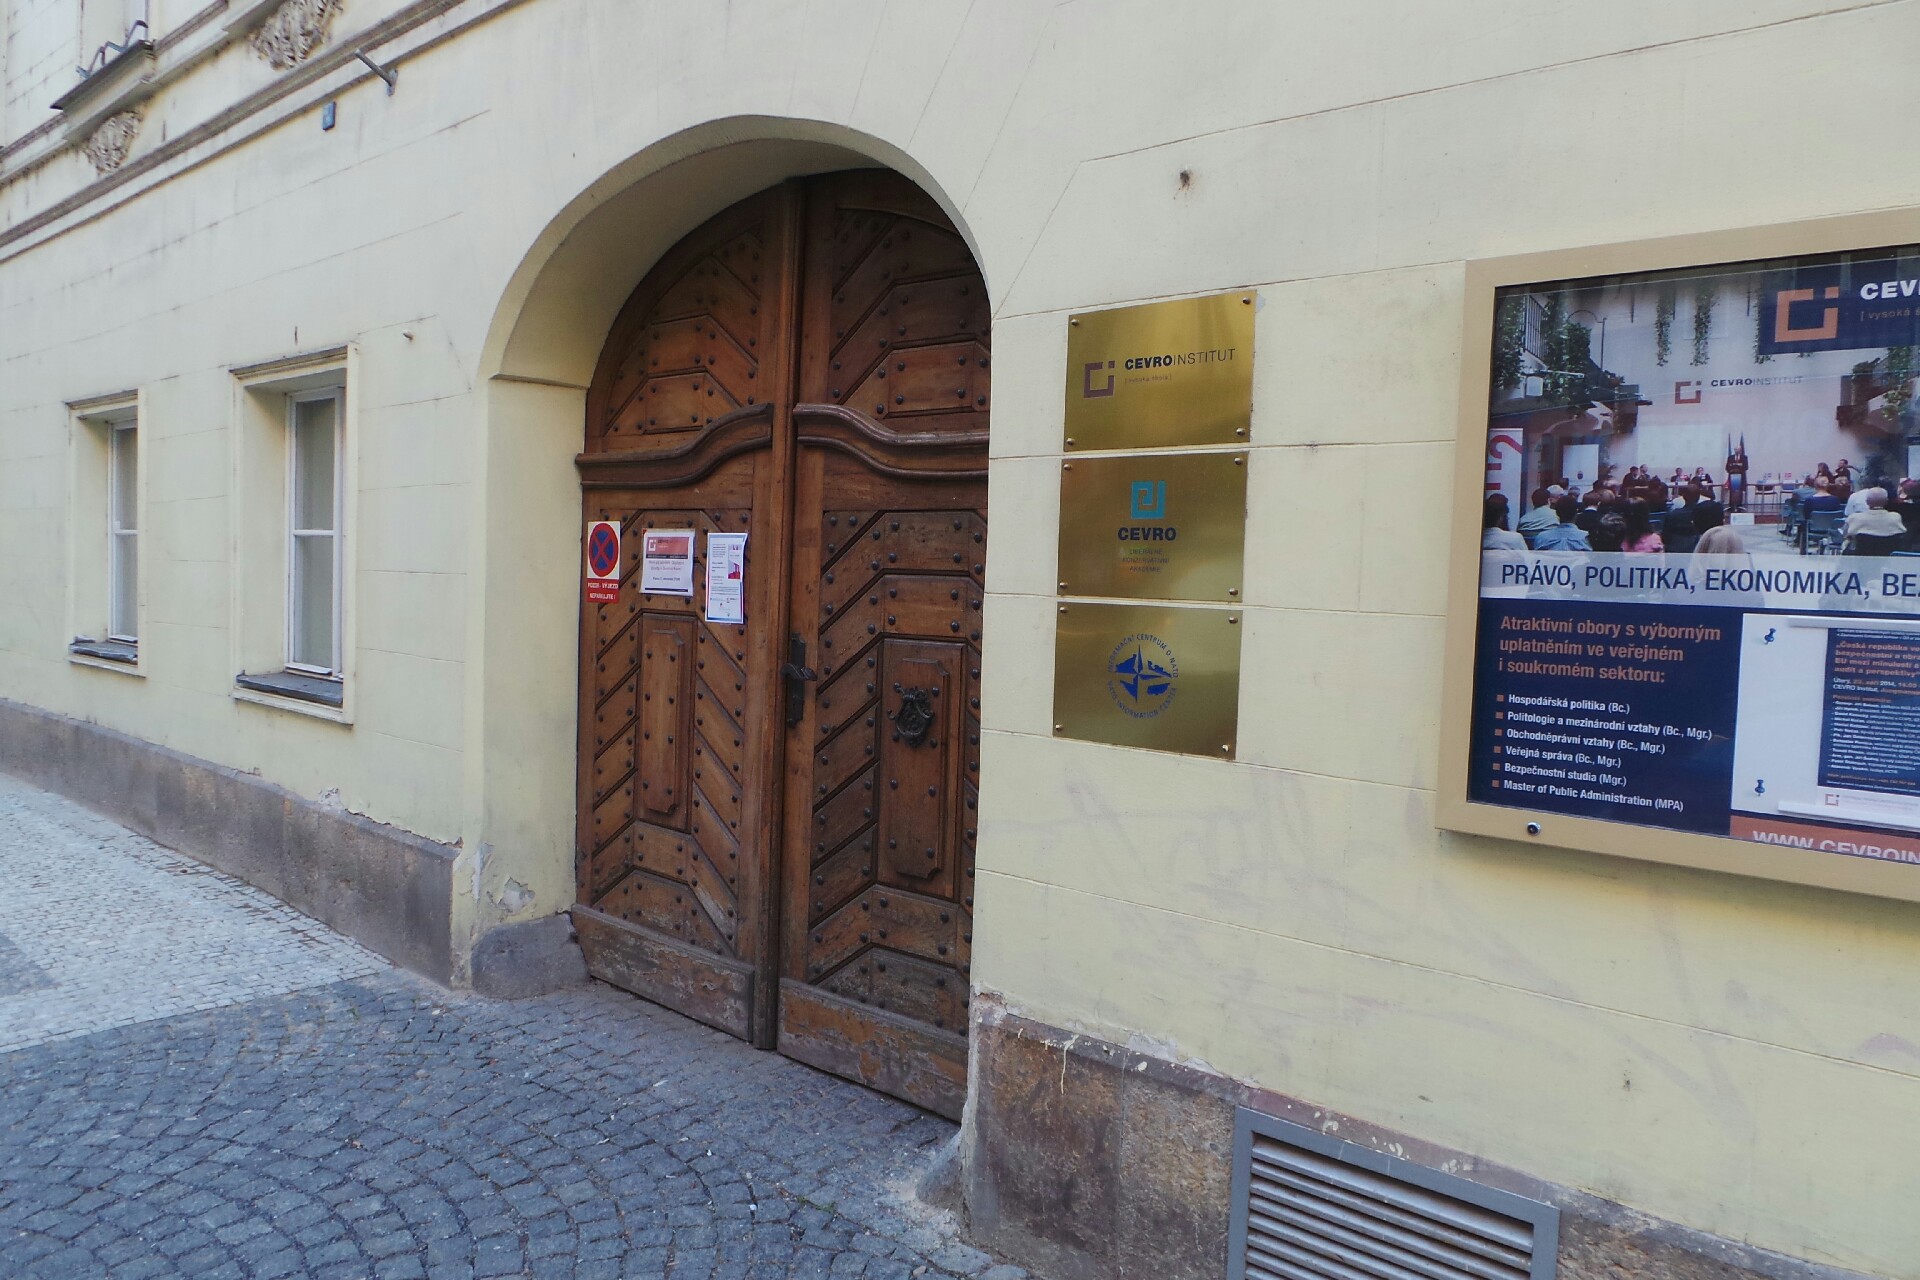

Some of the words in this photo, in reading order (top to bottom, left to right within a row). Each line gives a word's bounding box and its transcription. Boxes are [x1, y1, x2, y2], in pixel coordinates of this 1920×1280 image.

[1860, 280, 1920, 300] CEV
[1124, 348, 1236, 370] CEVROINSTITUT
[1711, 375, 1804, 387] CEVROINSTITUT
[1118, 527, 1177, 541] CEVRO
[1501, 560, 1576, 590] PRÁVO,
[1585, 566, 1695, 594] POLITIKA,
[1705, 569, 1870, 600] EKONOMIKA,
[1882, 573, 1920, 597] BE
[1500, 615, 1573, 633] Atraktivní
[1577, 619, 1621, 638] obory
[1626, 624, 1635, 636] s
[1640, 622, 1721, 643] výborným
[1136, 633, 1167, 650] CENTRUM
[1169, 657, 1179, 678] NATO
[1500, 637, 1582, 655] uplatněním
[1587, 644, 1604, 656] ve
[1609, 645, 1684, 662] veřejném
[1498, 658, 1503, 671] i
[1507, 659, 1594, 678] soukromém
[1599, 666, 1665, 683] sektoru:
[1508, 694, 1568, 707] Hospodářská
[1570, 699, 1606, 711] politika
[1608, 702, 1630, 715] (Bc.)
[1507, 711, 1555, 725] Politologie
[1566, 717, 1625, 731] mezinárodní
[1627, 723, 1660, 736] vztahy
[1662, 725, 1684, 738] (Bc.,
[1687, 727, 1713, 741] Mgr.)
[1506, 728, 1581, 744] Obchodněprávní
[1583, 736, 1615, 749] vztahy
[1617, 739, 1638, 751] (Bc.,
[1640, 741, 1666, 755] Mgr.)
[1505, 745, 1540, 758] Veřejná
[1542, 750, 1573, 761] správa
[1575, 753, 1595, 765] (Bc.,
[1597, 755, 1622, 768] Mgr.)
[1504, 762, 1566, 778] Bezpečnostní
[1567, 771, 1597, 782] studia
[1599, 773, 1627, 787] (Mgr.)
[1503, 779, 1535, 792] Master
[1537, 784, 1547, 793] of
[1549, 785, 1578, 797] Public
[1580, 789, 1652, 807] Administration
[1654, 798, 1684, 812] (MPA)
